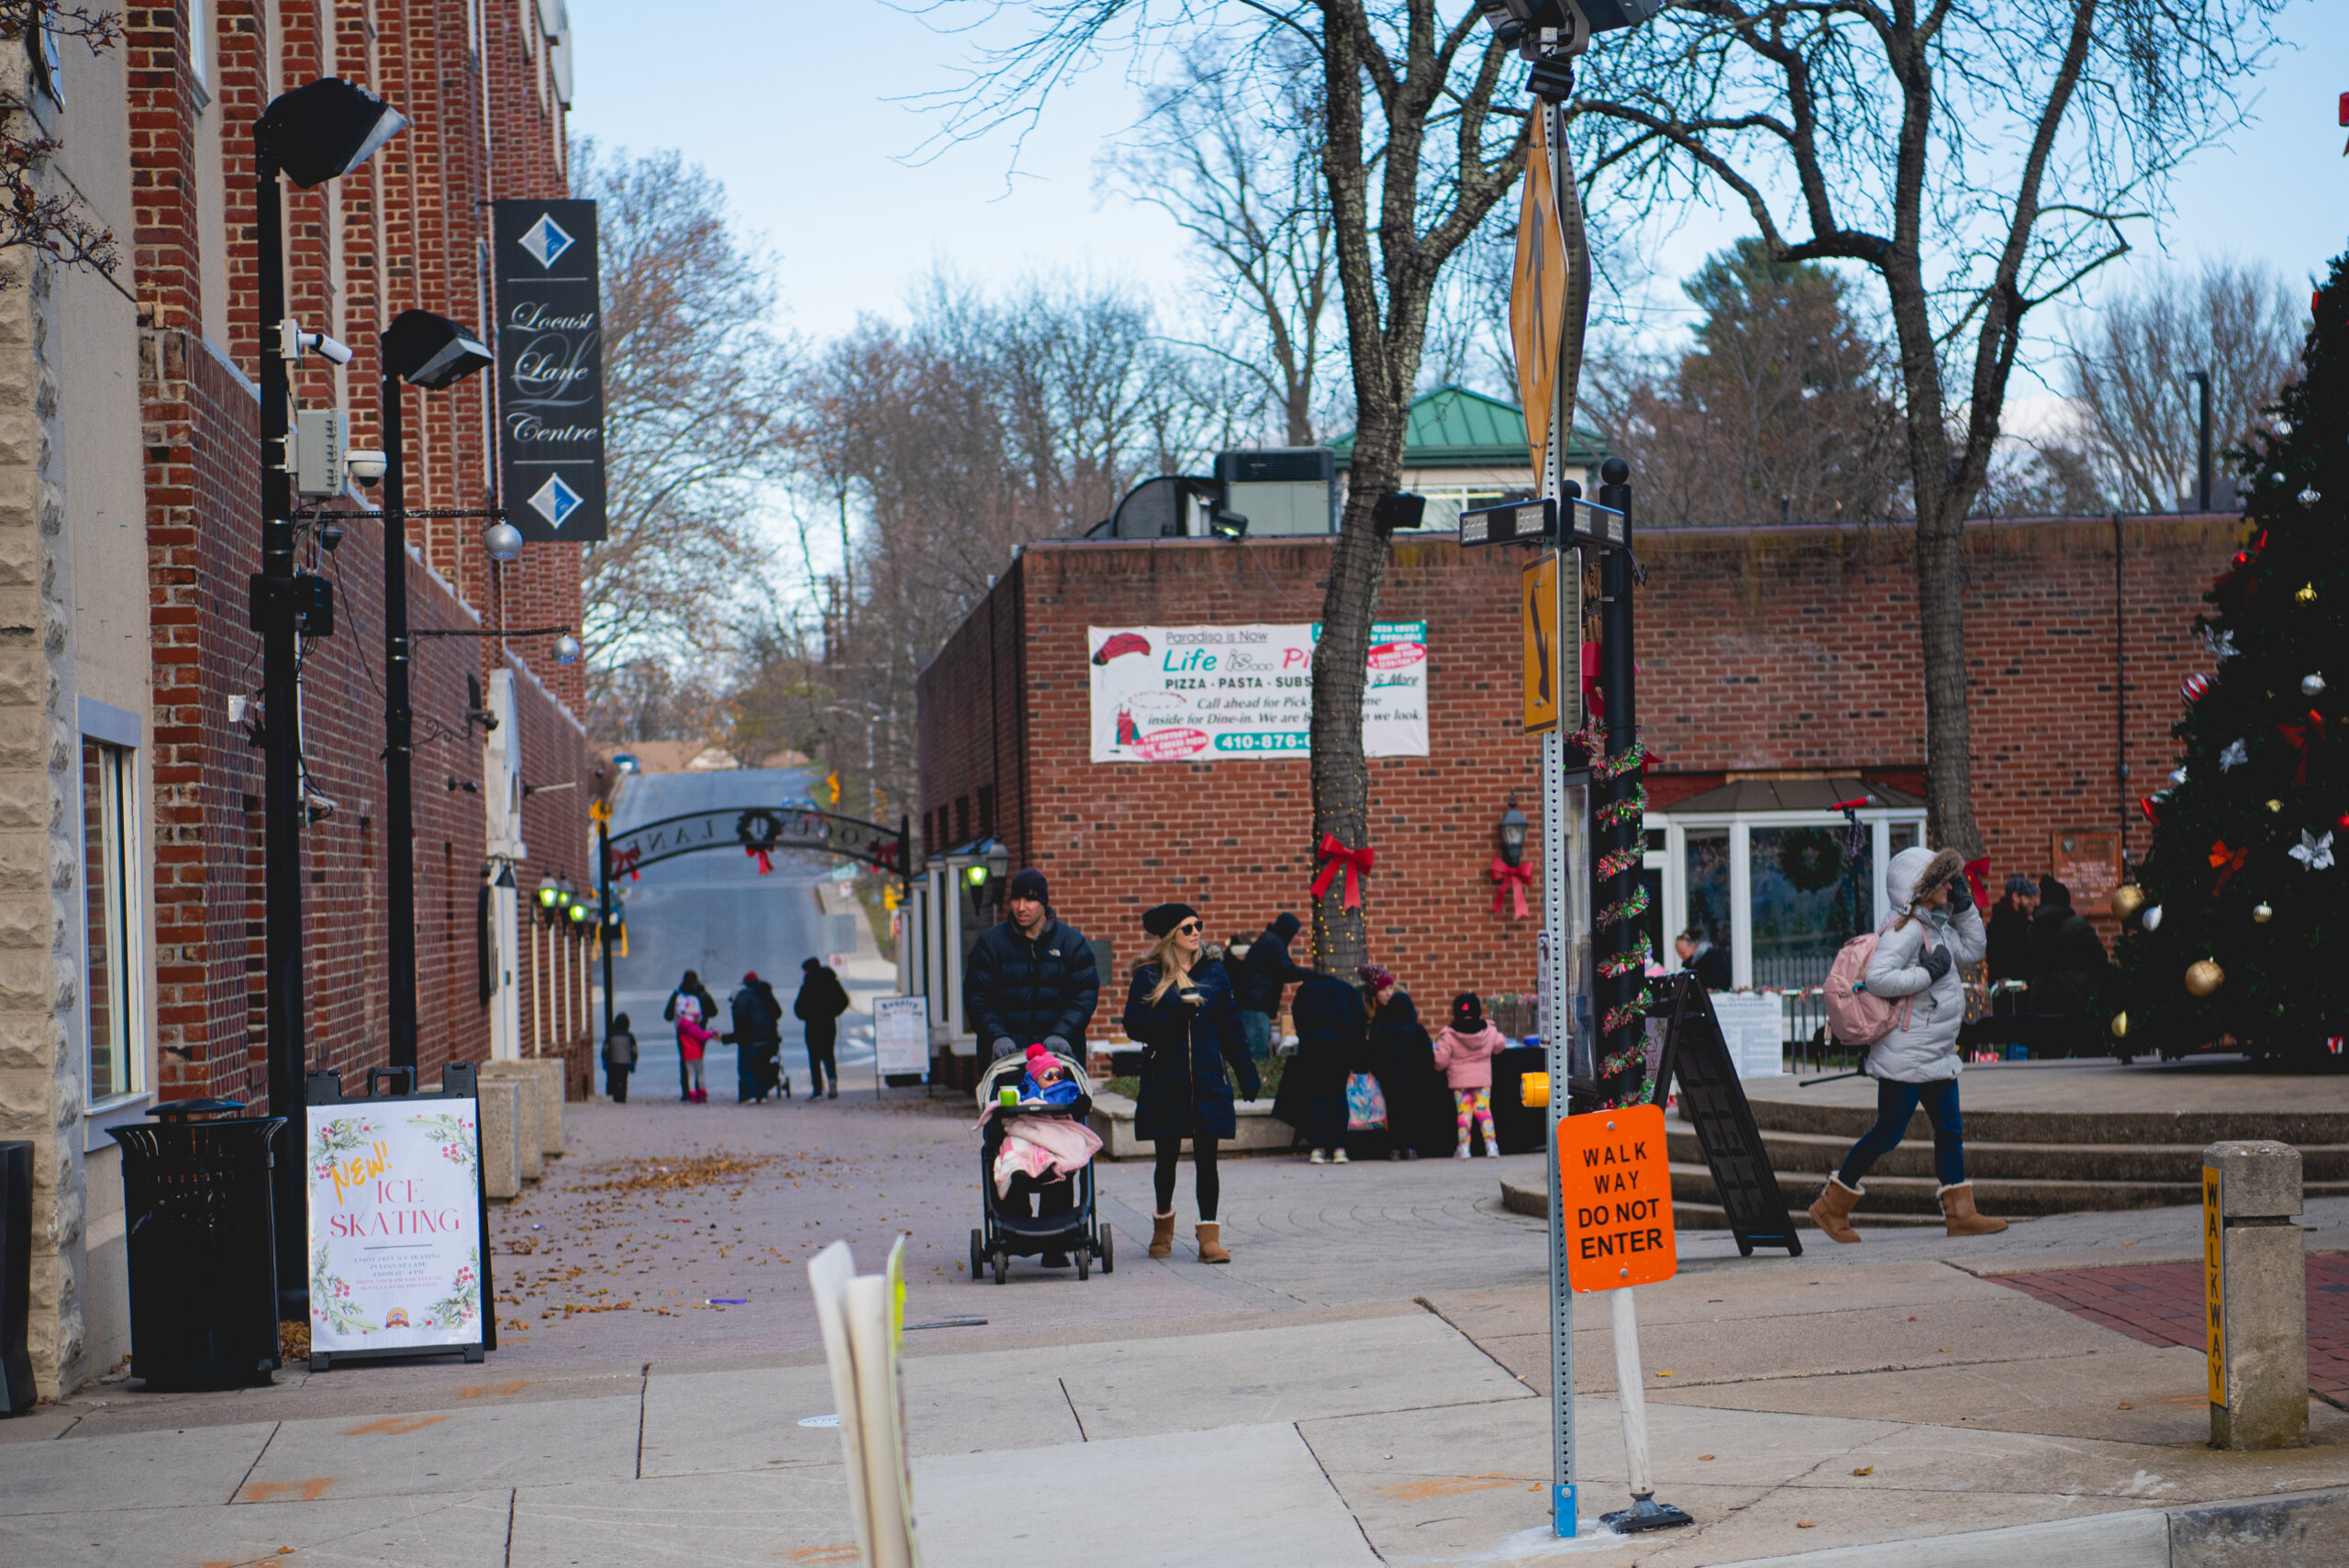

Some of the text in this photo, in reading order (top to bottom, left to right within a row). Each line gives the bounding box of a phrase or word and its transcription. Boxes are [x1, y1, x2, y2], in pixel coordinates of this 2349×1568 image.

[507, 302, 595, 332] Locust
[510, 350, 589, 383] Lane
[506, 412, 597, 442] Centre
[1166, 630, 1268, 644] Paradiso is Now
[1163, 648, 1218, 672] Life
[1283, 648, 1312, 669] Pi
[1165, 679, 1206, 689] PIZZA
[1219, 677, 1263, 688] PASTA
[1374, 673, 1384, 685] &
[1389, 673, 1419, 685] More
[1197, 697, 1220, 709] Call
[1224, 697, 1260, 709] ahead
[1264, 696, 1280, 708] for
[1284, 695, 1312, 707] Pick-
[1148, 714, 1184, 726] inside
[1187, 713, 1204, 725] for
[1207, 713, 1253, 725] Dine-in.
[1259, 713, 1276, 723] We
[1280, 714, 1299, 722] are
[1394, 708, 1422, 720] look.
[1583, 1141, 1647, 1168] WALK
[330, 1140, 393, 1206] NEW!
[1594, 1170, 1640, 1195] WAY
[377, 1178, 425, 1205] ICE
[329, 1208, 460, 1239] SKATING
[1578, 1198, 1659, 1229] DO NOT
[1581, 1228, 1664, 1260] ENTER
[2207, 1181, 2222, 1390] WALKWAY
